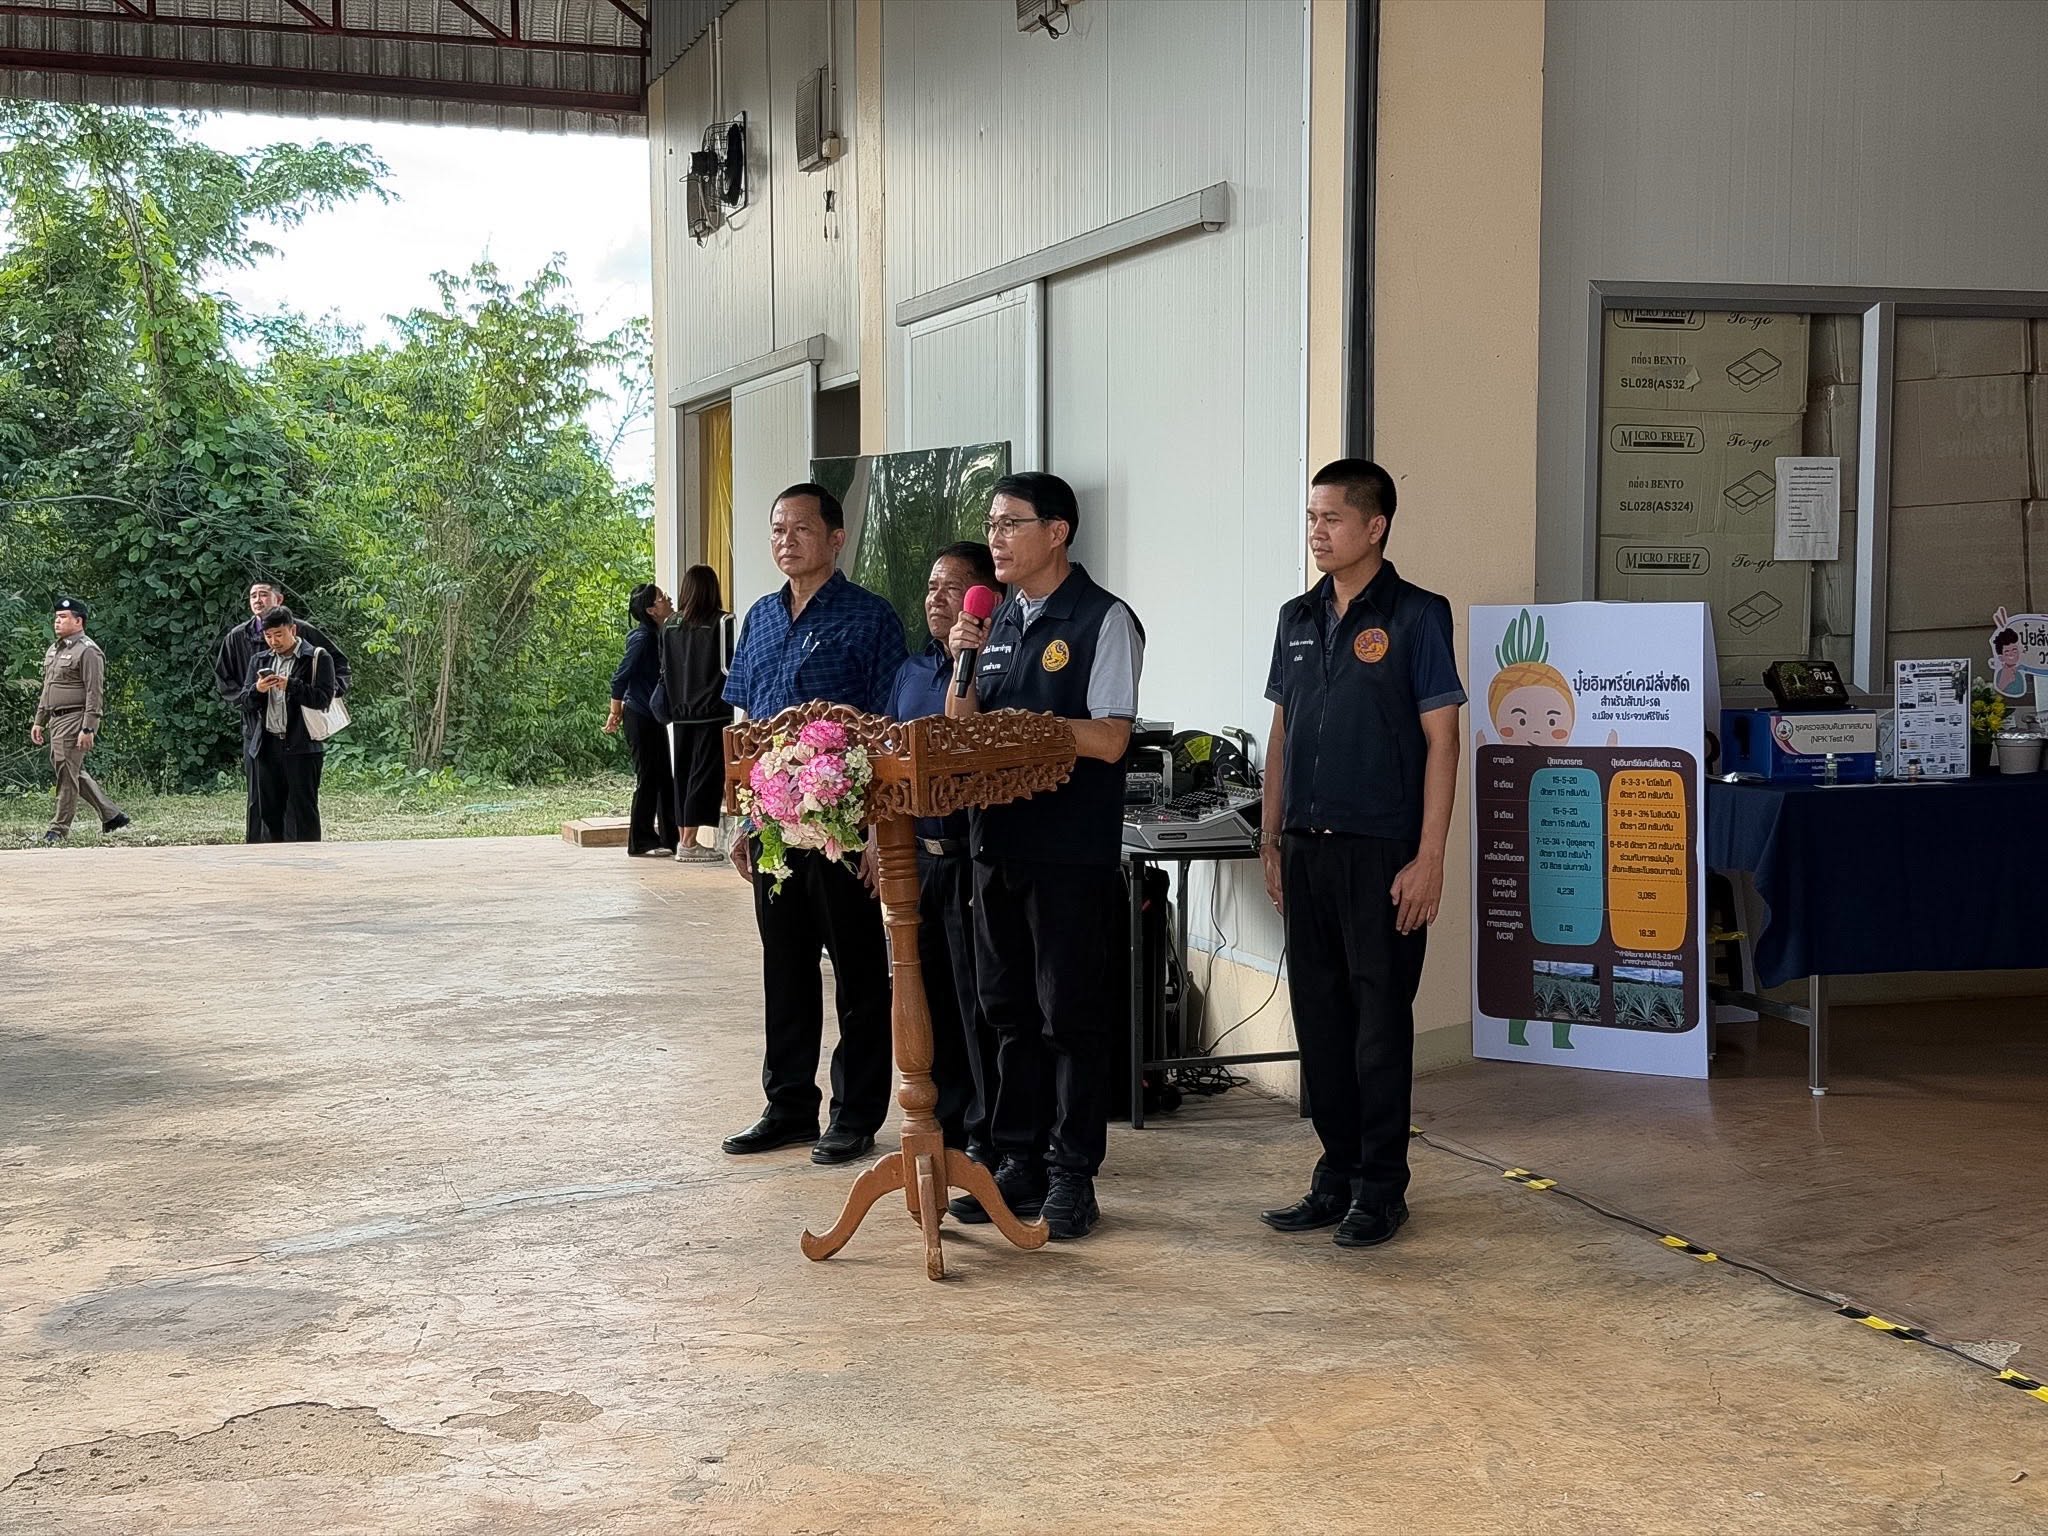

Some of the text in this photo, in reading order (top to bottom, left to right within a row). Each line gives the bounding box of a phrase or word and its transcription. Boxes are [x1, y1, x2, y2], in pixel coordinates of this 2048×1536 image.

[1727, 312, 1773, 330] To-go
[1631, 352, 1686, 365] กล่อง BENTO
[1620, 377, 1695, 392] SL028(AS32)
[1620, 430, 1696, 448] MICRO FREEZ
[1727, 433, 1773, 453] To-go
[1628, 476, 1684, 489] กล่อง BENTO
[1619, 501, 1694, 513] SL028(AS324)
[1625, 552, 1700, 569] MICRO FREEZ
[1731, 553, 1776, 573] To-go
[1573, 669, 1690, 697] ปุ๋ยอินทรีย์เคมีสั่งตัด
[1600, 695, 1660, 707] สำหรับสับปะรด
[1592, 709, 1670, 721] อ.เมือง จ.ประจวบคีรีขันธ์
[1795, 722, 1873, 733] ชุดตรวจสอบดินภาคสนาม
[1811, 735, 1828, 744] (NPK
[1843, 735, 1855, 743] Kit)
[1552, 776, 1578, 785] 15-5-20
[1638, 791, 1646, 799] 20
[1552, 807, 1578, 815] 15-5-20
[1558, 819, 1565, 827] 15
[1648, 841, 1657, 849] 20
[1496, 931, 1514, 941] (VCR)
